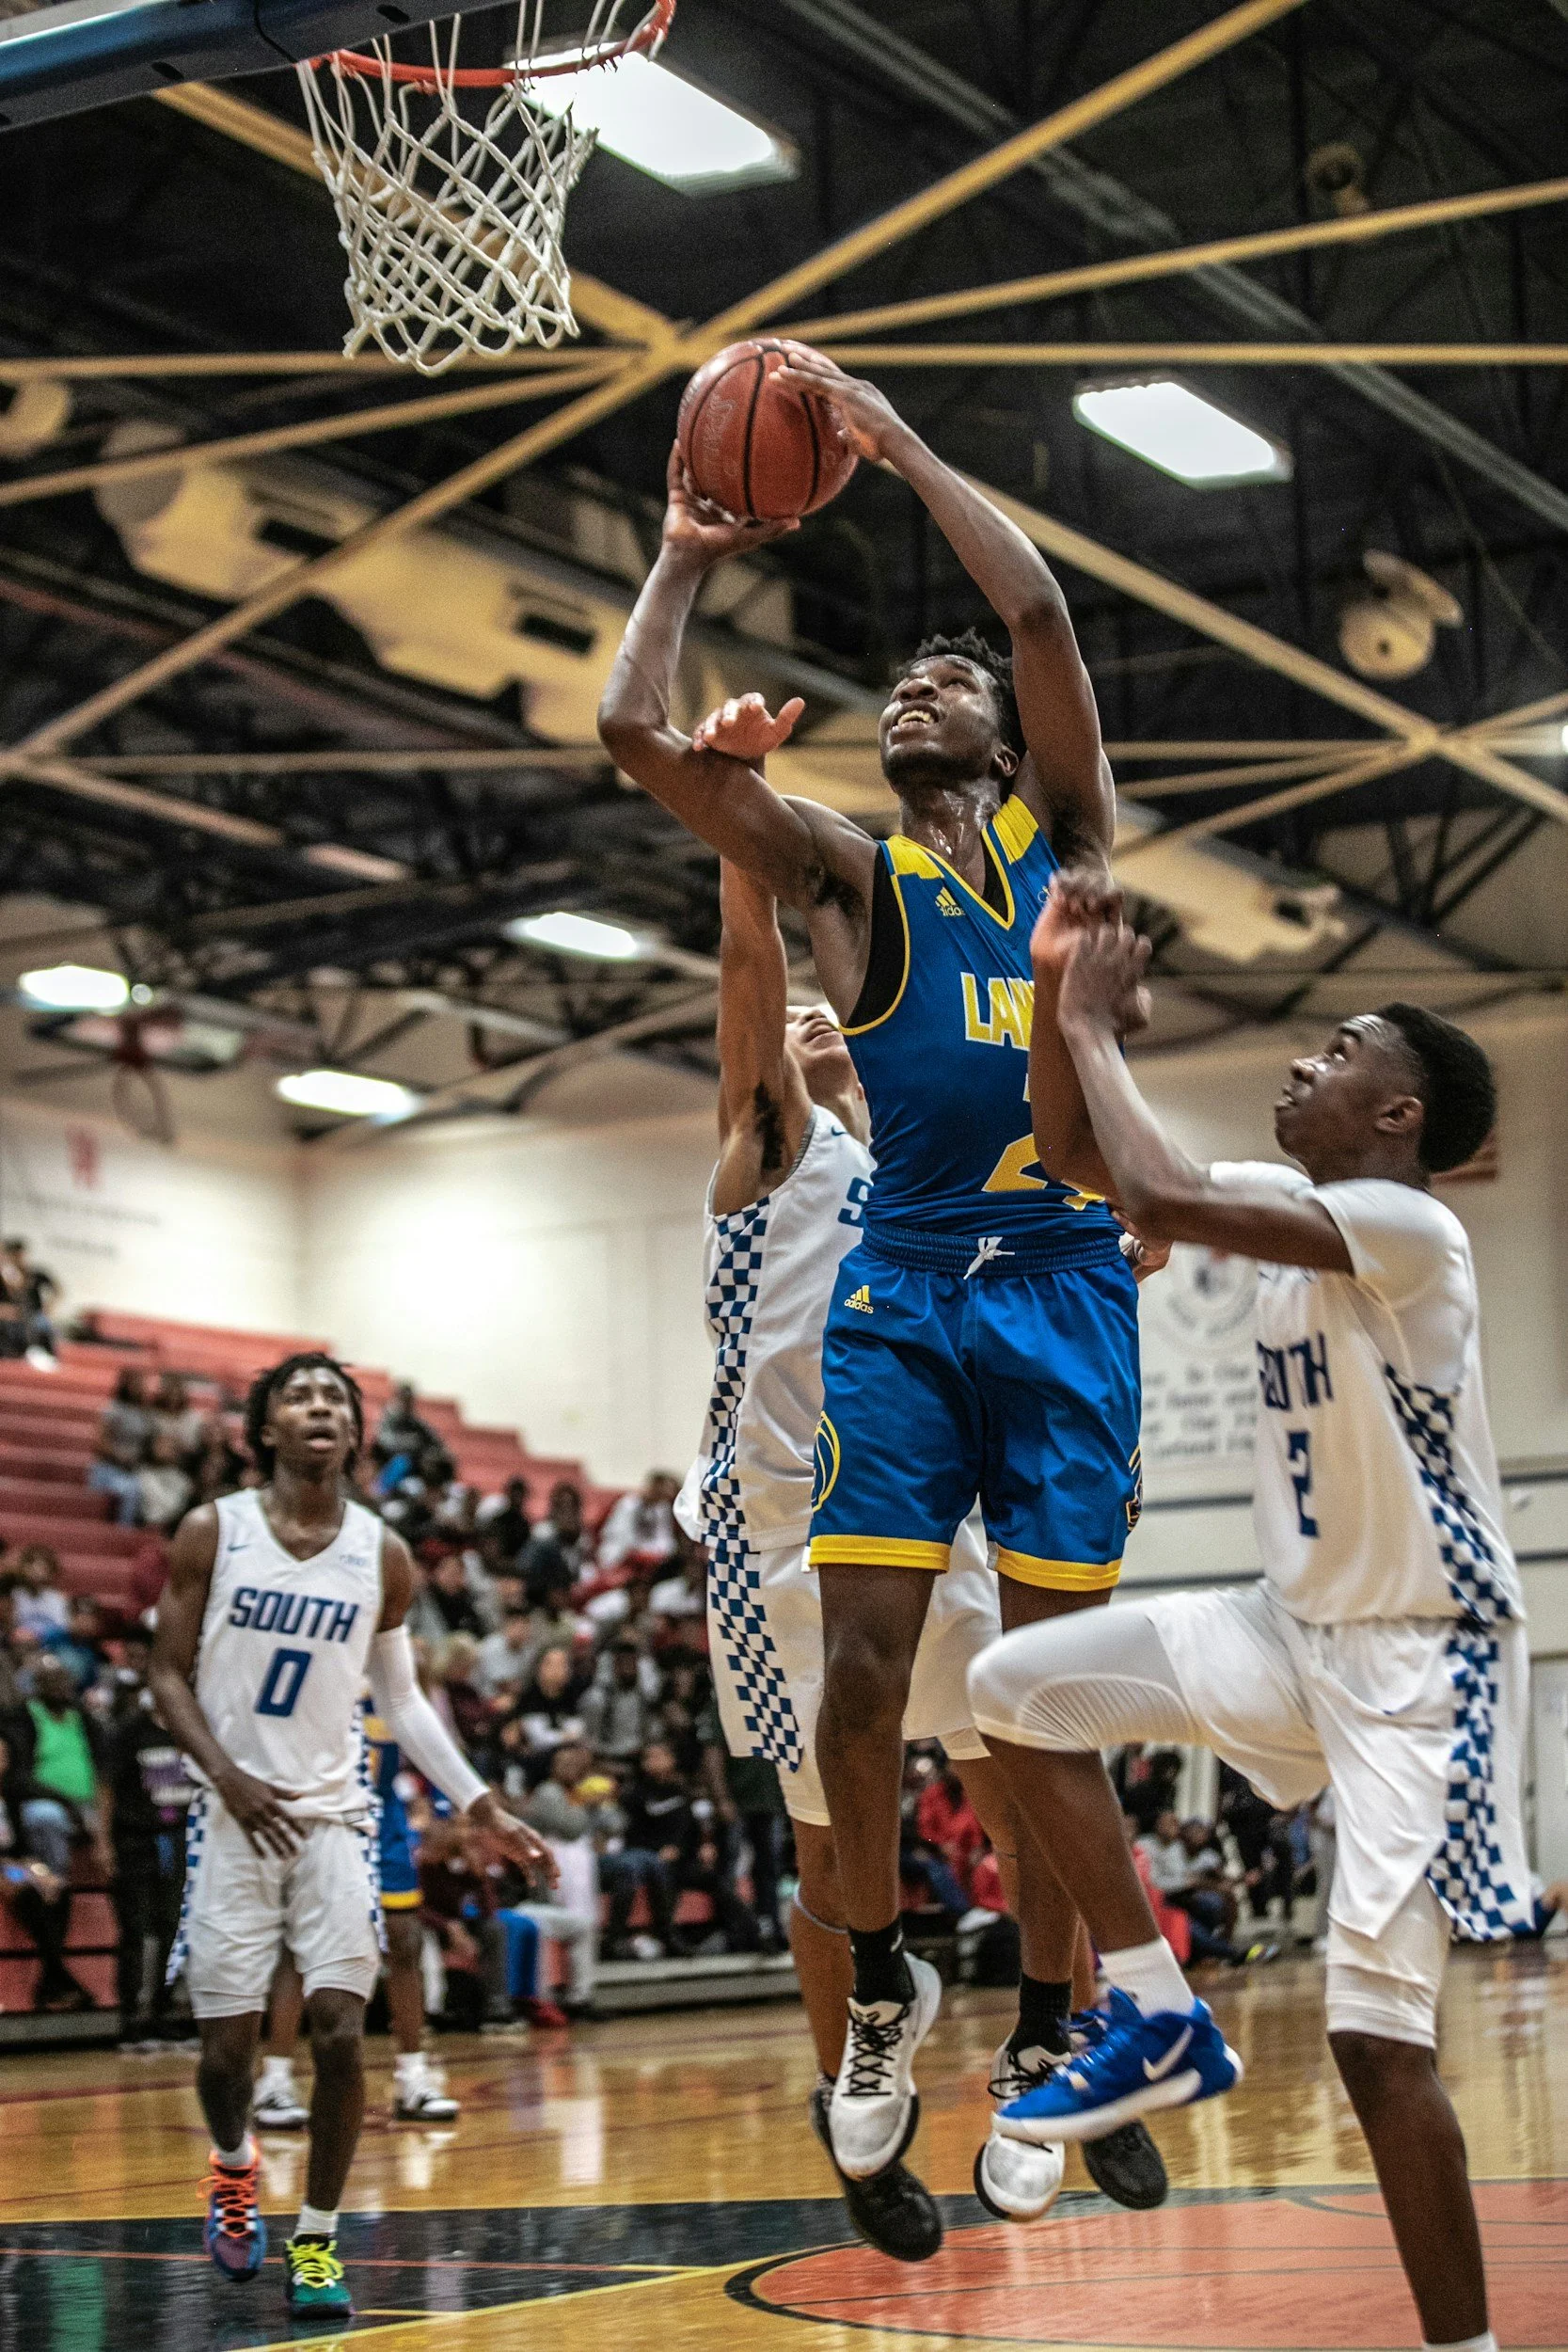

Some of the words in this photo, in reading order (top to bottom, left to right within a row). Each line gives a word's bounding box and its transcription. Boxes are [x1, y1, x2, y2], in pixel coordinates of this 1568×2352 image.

[844, 1297, 875, 1315] adidas
[1287, 1430, 1320, 1539] 2
[229, 1585, 360, 1644] SOUTH
[254, 1647, 314, 1718] 0
